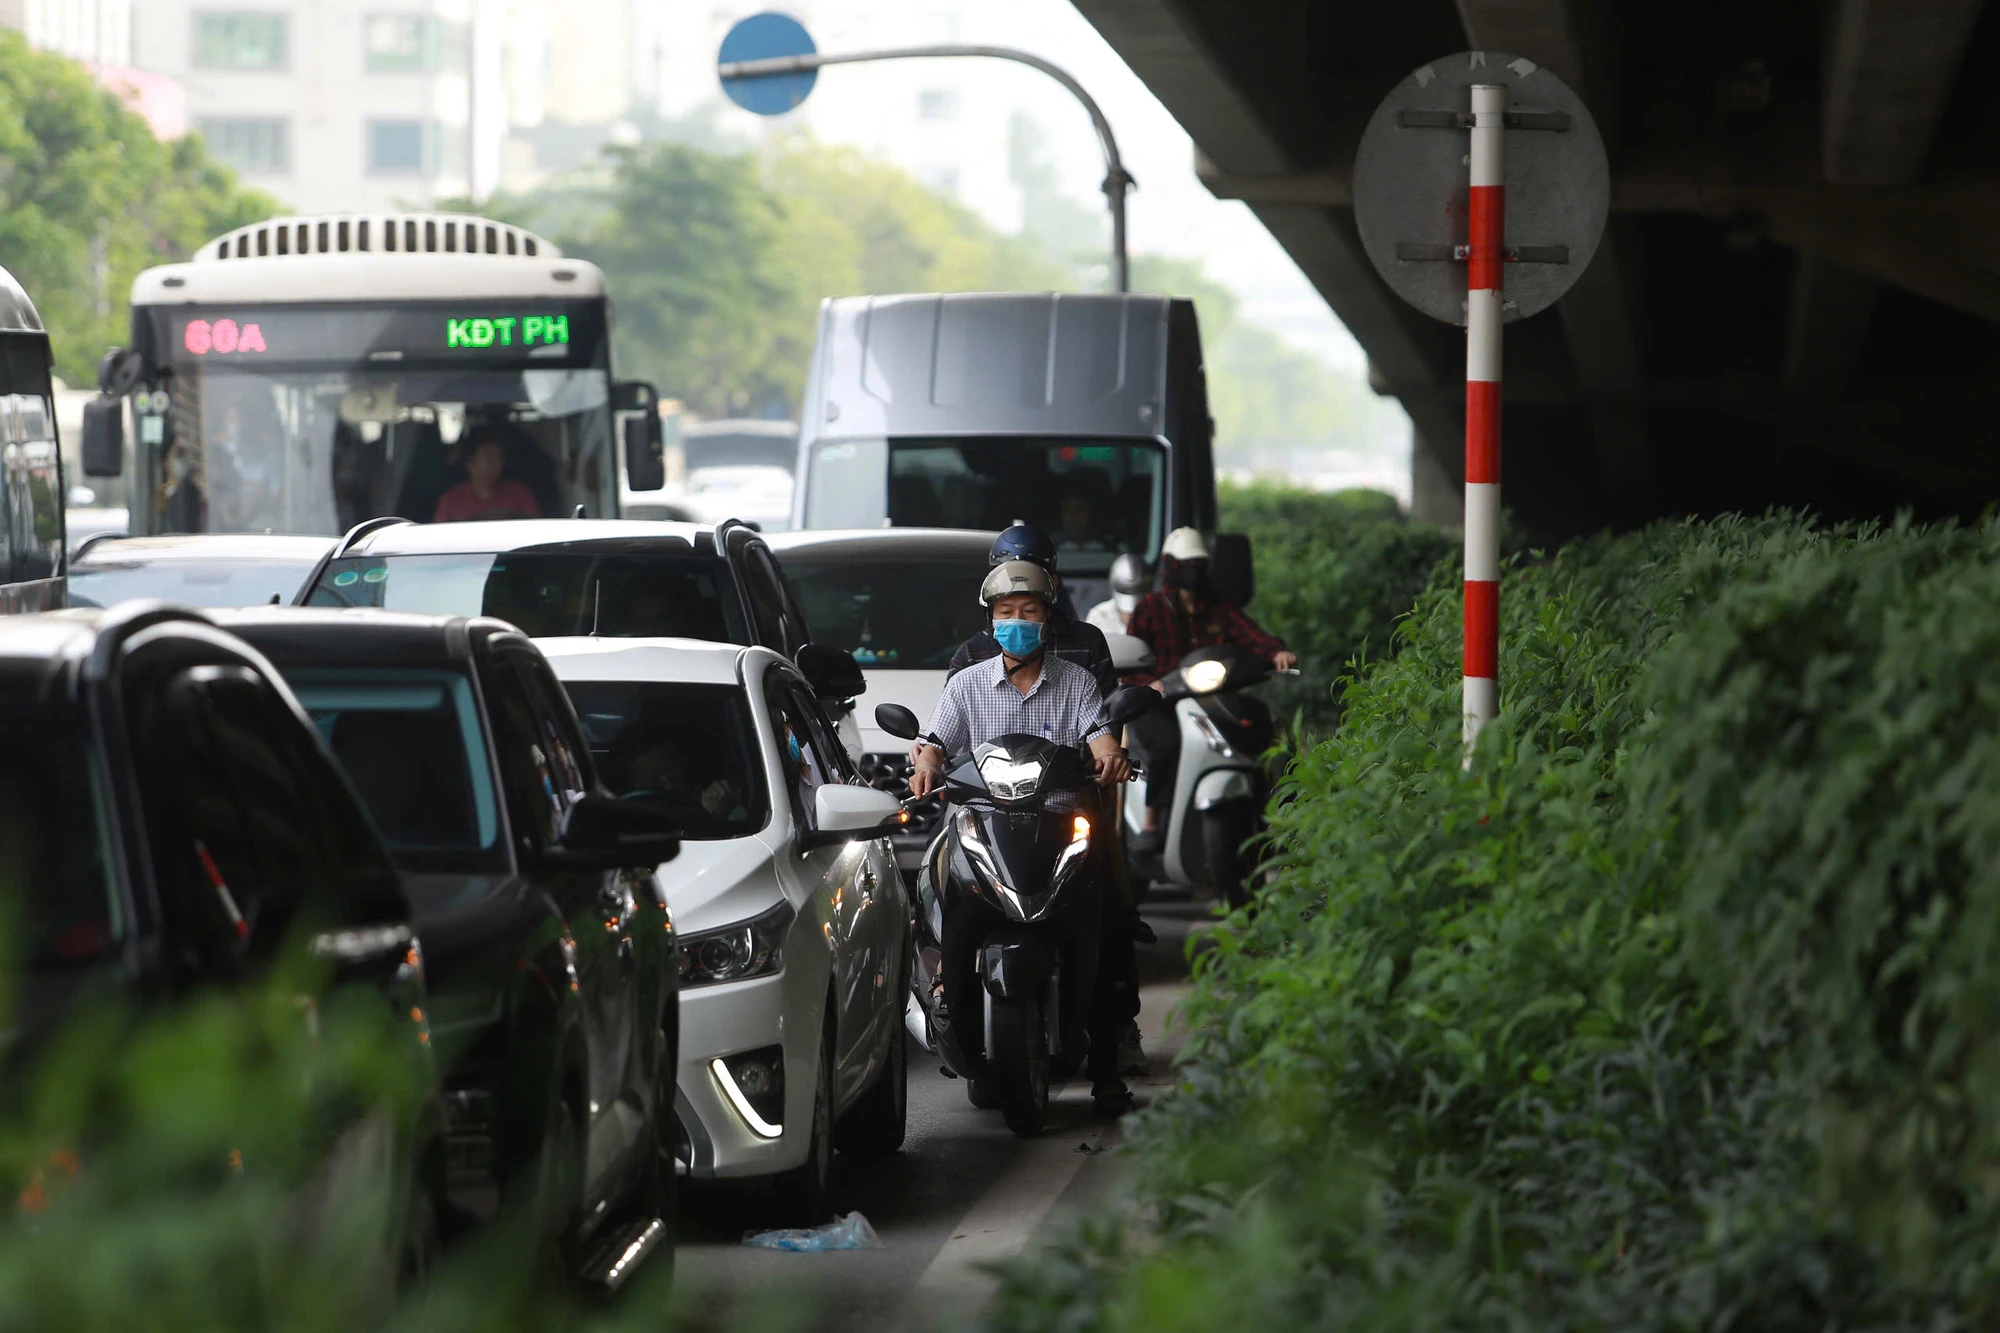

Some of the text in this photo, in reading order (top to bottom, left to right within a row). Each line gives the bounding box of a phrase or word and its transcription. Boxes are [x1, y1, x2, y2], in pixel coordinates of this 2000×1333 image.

[184, 319, 267, 354] 60A
[447, 315, 569, 348] KĐT PH
